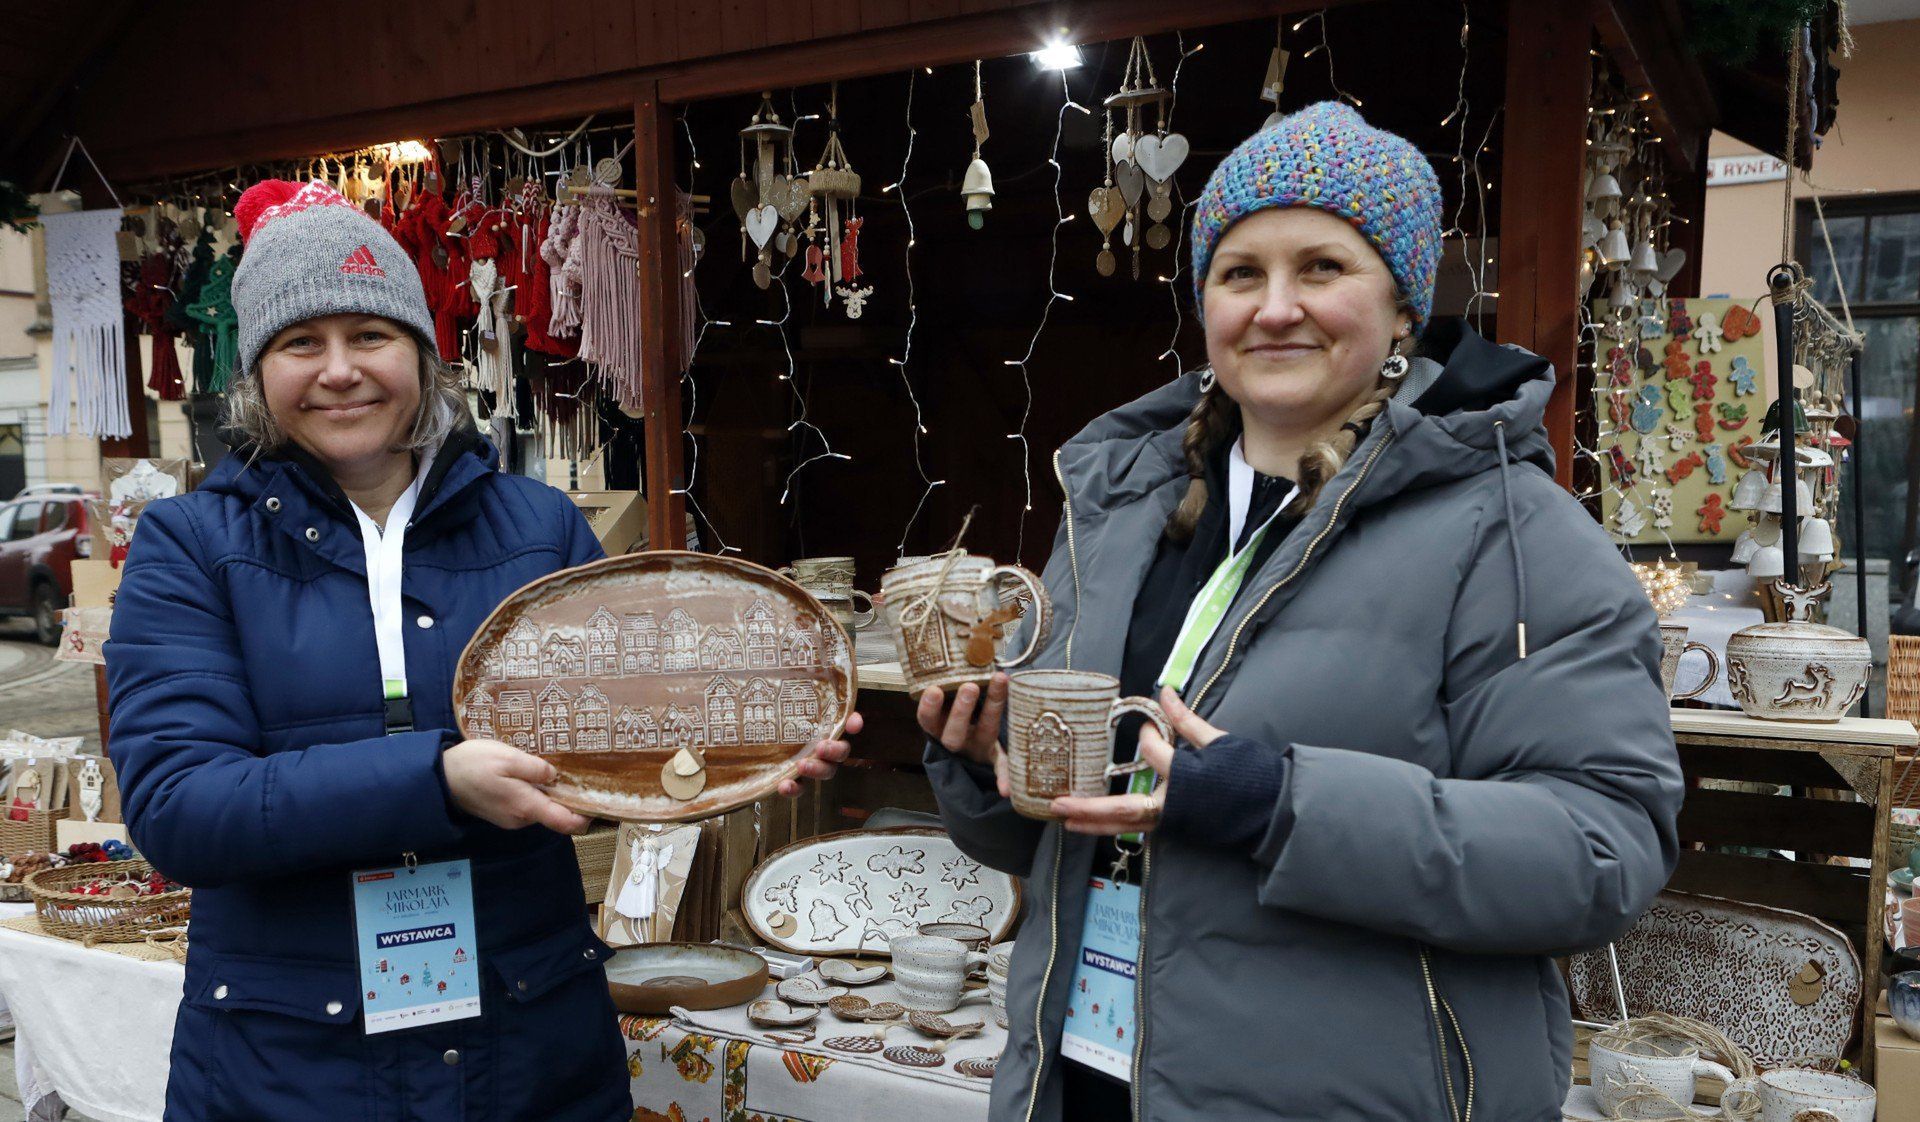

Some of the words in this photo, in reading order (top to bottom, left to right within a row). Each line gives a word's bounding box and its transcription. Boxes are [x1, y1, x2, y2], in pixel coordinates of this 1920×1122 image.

[1724, 160, 1781, 177] RYNEK
[339, 264, 387, 279] adidas
[386, 885, 446, 902] JARMARK
[380, 926, 453, 946] WYSTAWCA
[1084, 950, 1137, 976] WYSTAWCA
